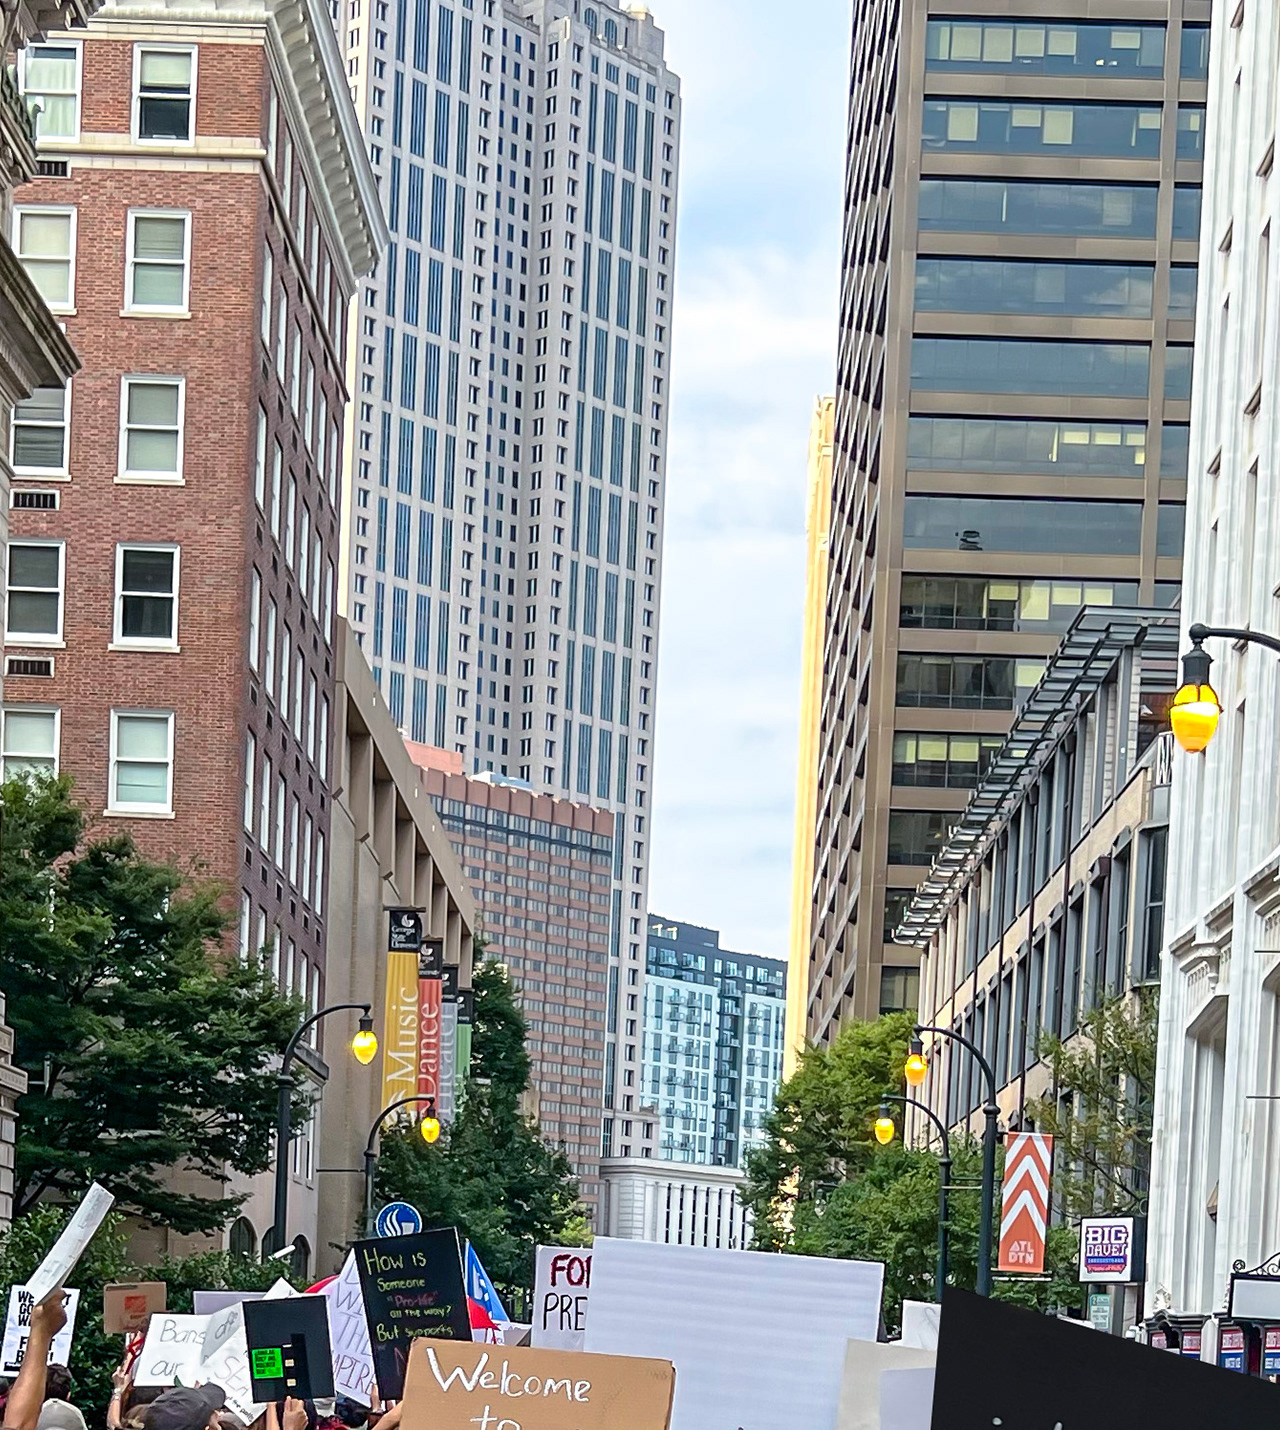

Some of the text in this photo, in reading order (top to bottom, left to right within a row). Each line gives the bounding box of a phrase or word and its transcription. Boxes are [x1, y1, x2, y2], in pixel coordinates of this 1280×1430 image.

[386, 987, 419, 1084] Music
[417, 1003, 439, 1098] Dance
[1086, 1226, 1128, 1244] BIG
[1009, 1241, 1034, 1251] ATL
[363, 1247, 404, 1276] How
[1008, 1252, 1034, 1264] DTN
[376, 1278, 426, 1293] Someone
[159, 1319, 206, 1345] Bans
[376, 1323, 399, 1342] But
[150, 1360, 184, 1376] our
[426, 1346, 593, 1402] Welcome
